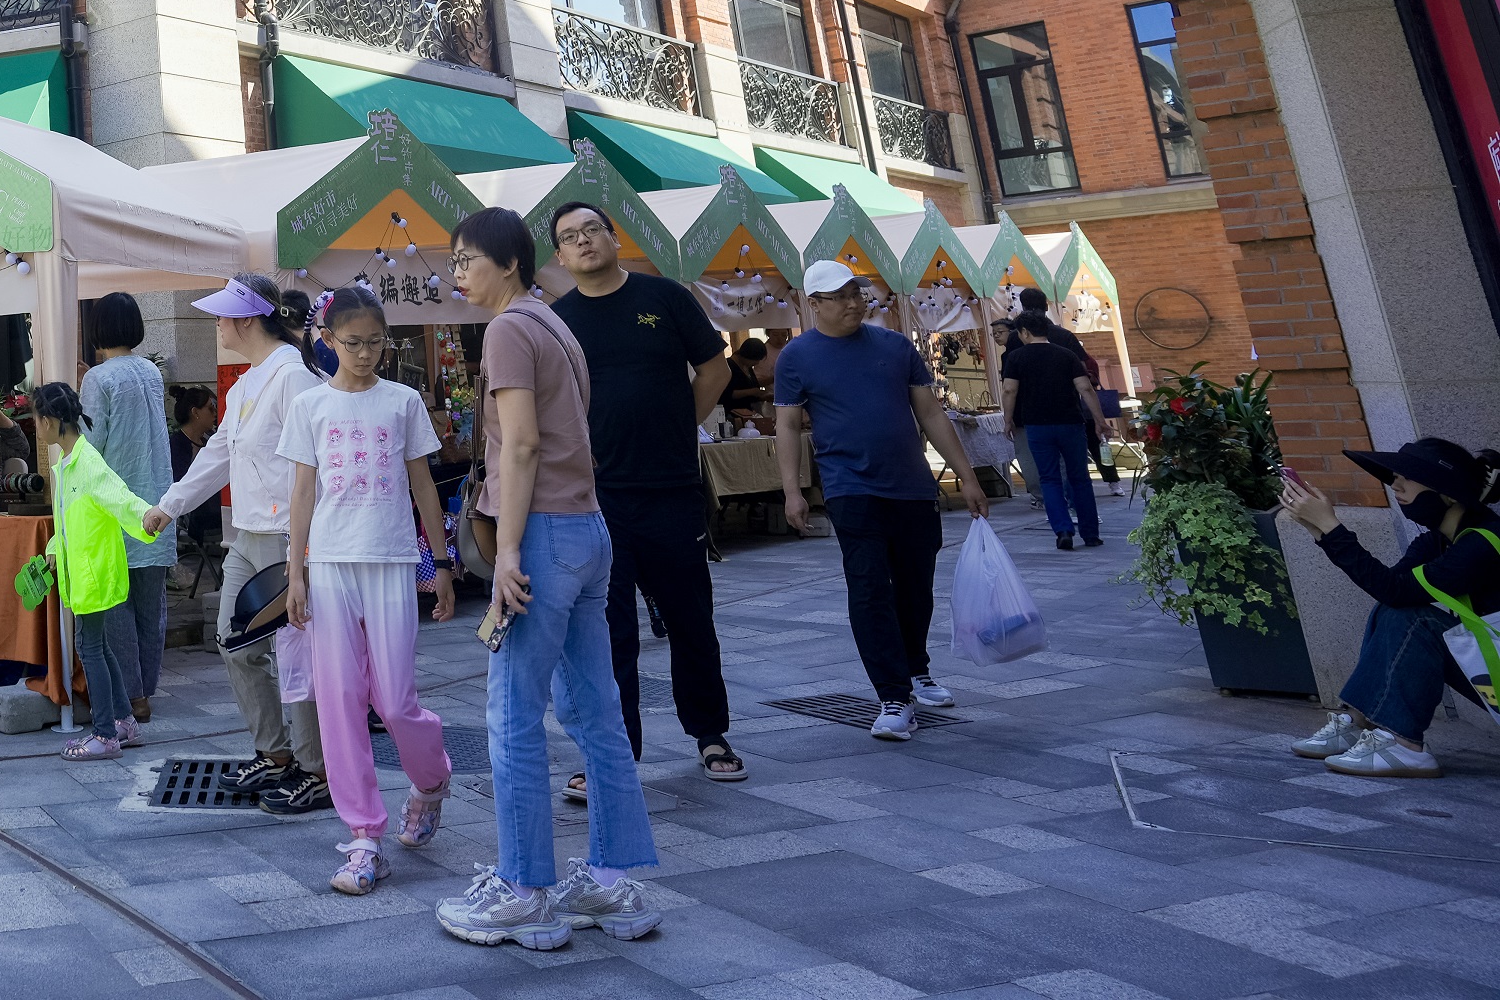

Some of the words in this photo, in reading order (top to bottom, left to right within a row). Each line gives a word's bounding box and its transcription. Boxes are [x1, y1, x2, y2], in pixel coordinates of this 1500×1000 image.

[369, 112, 398, 164] 培仁
[399, 133, 414, 187] 好物市集
[574, 139, 598, 186] 培仁
[720, 164, 738, 205] 培仁
[291, 189, 336, 236] 城东好市
[314, 193, 359, 237] 可寻美好
[359, 270, 442, 305] 编邂逅
